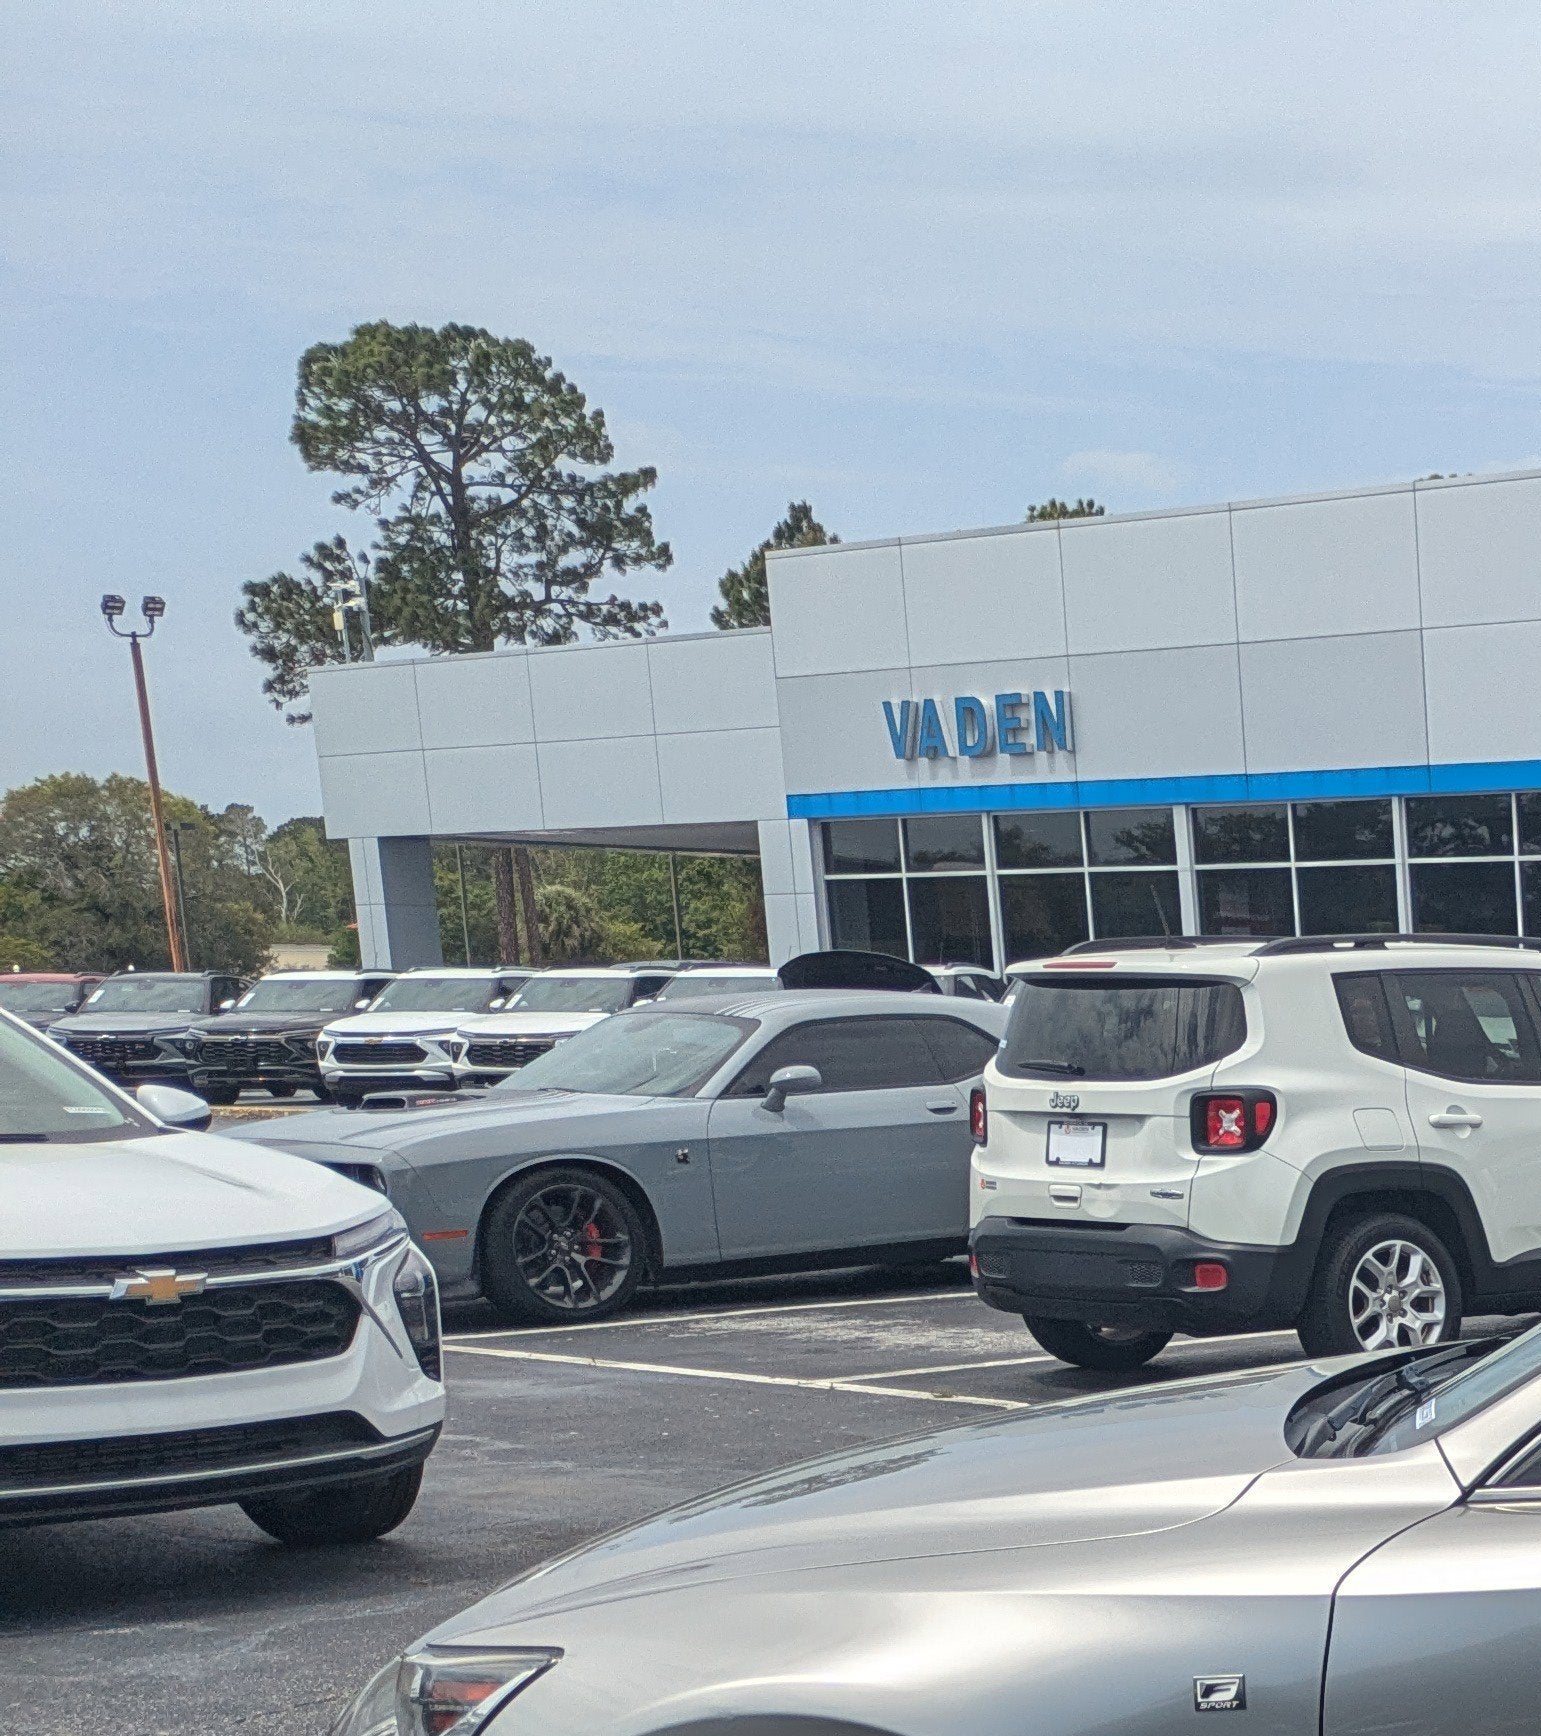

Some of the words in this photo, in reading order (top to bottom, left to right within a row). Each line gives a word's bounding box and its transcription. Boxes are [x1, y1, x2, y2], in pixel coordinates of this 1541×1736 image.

[882, 689, 1071, 760] VADEN
[1049, 1091, 1079, 1111] Jeep
[1200, 1701, 1239, 1709] SPORT
